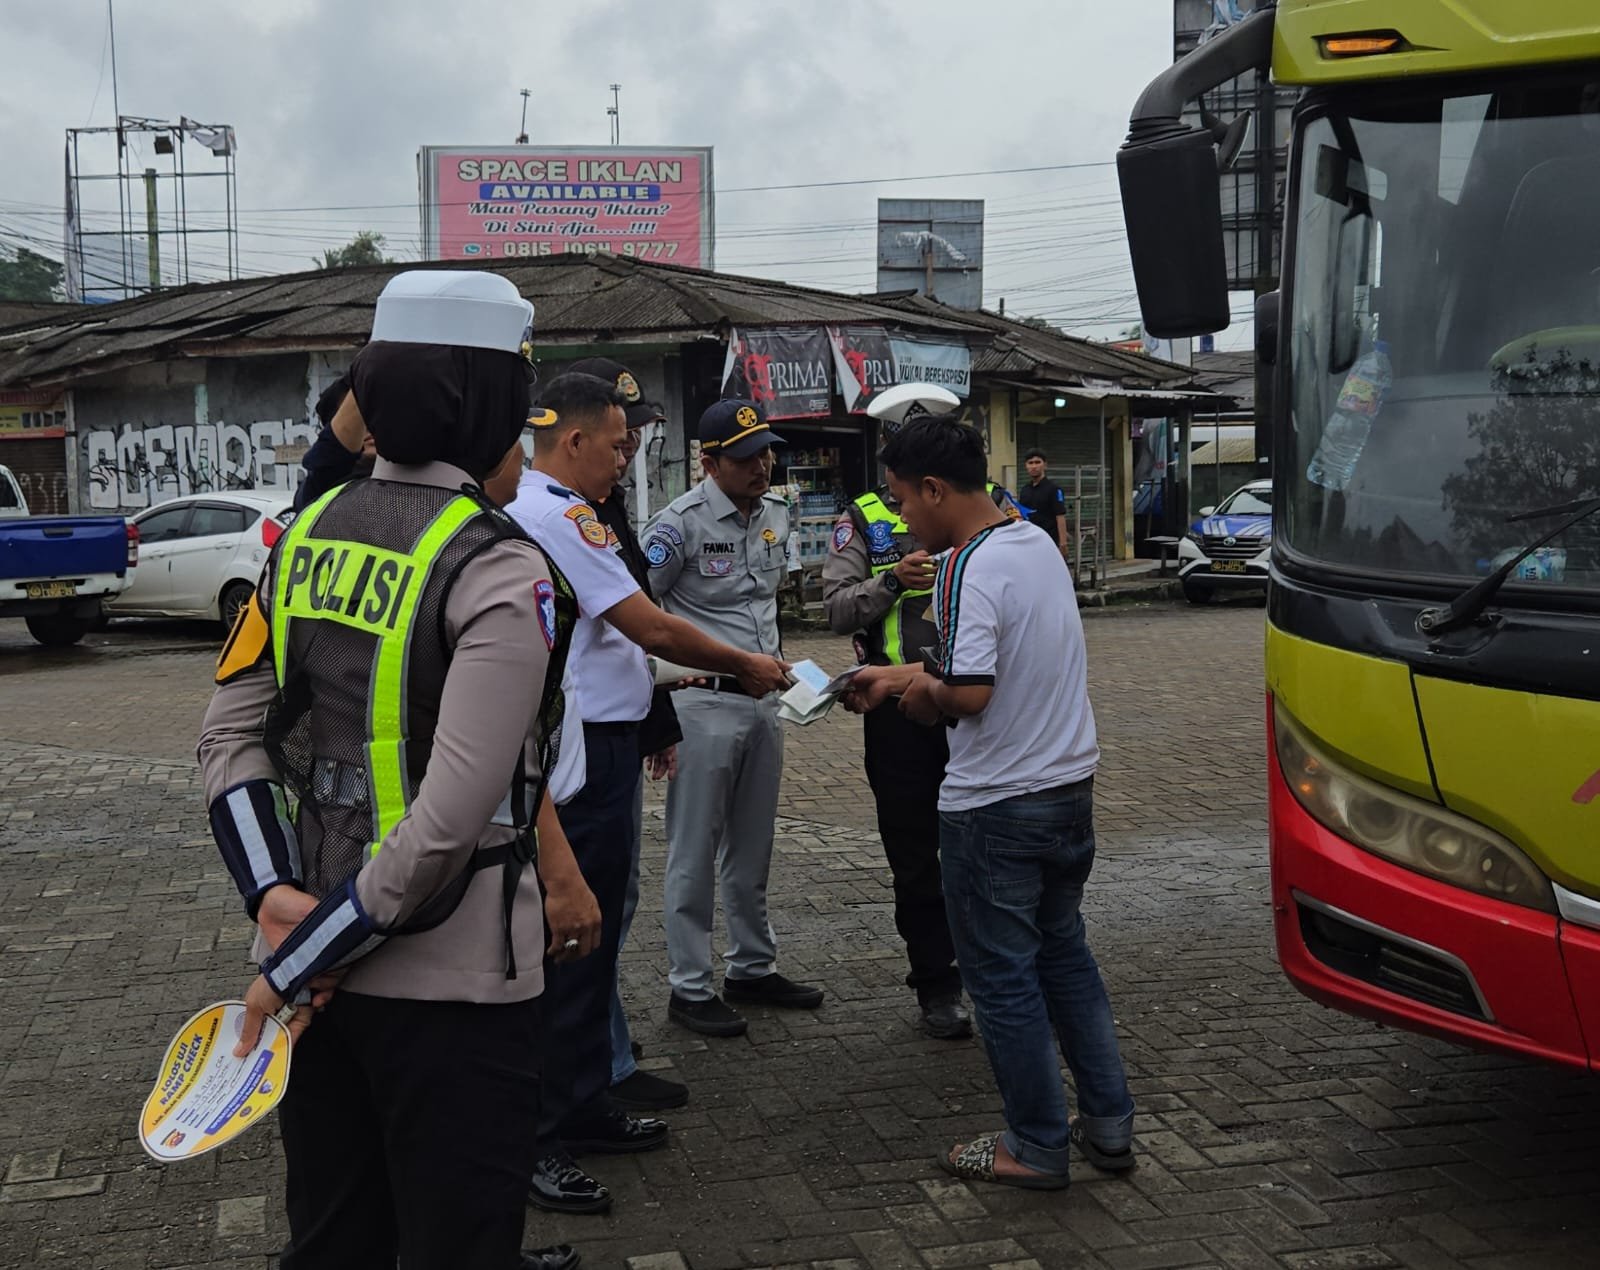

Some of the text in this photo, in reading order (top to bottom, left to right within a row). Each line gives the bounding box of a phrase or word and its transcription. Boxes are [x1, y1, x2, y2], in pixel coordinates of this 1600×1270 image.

[458, 160, 682, 182] SPACE IKLAN
[491, 185, 649, 200] AVAILABLE
[468, 202, 671, 219] Mau Pasang Iklan?
[483, 221, 507, 233] Di
[513, 220, 555, 234] Sini
[503, 241, 552, 257] 0815
[622, 242, 679, 258] 9777
[766, 360, 828, 390] PRIMA
[863, 359, 899, 385] PRI
[703, 543, 736, 554] FAWAZ
[284, 545, 415, 630] POLISI
[160, 1033, 203, 1105] RAMP CHECK
[161, 1042, 189, 1092] LOLOS UJI
